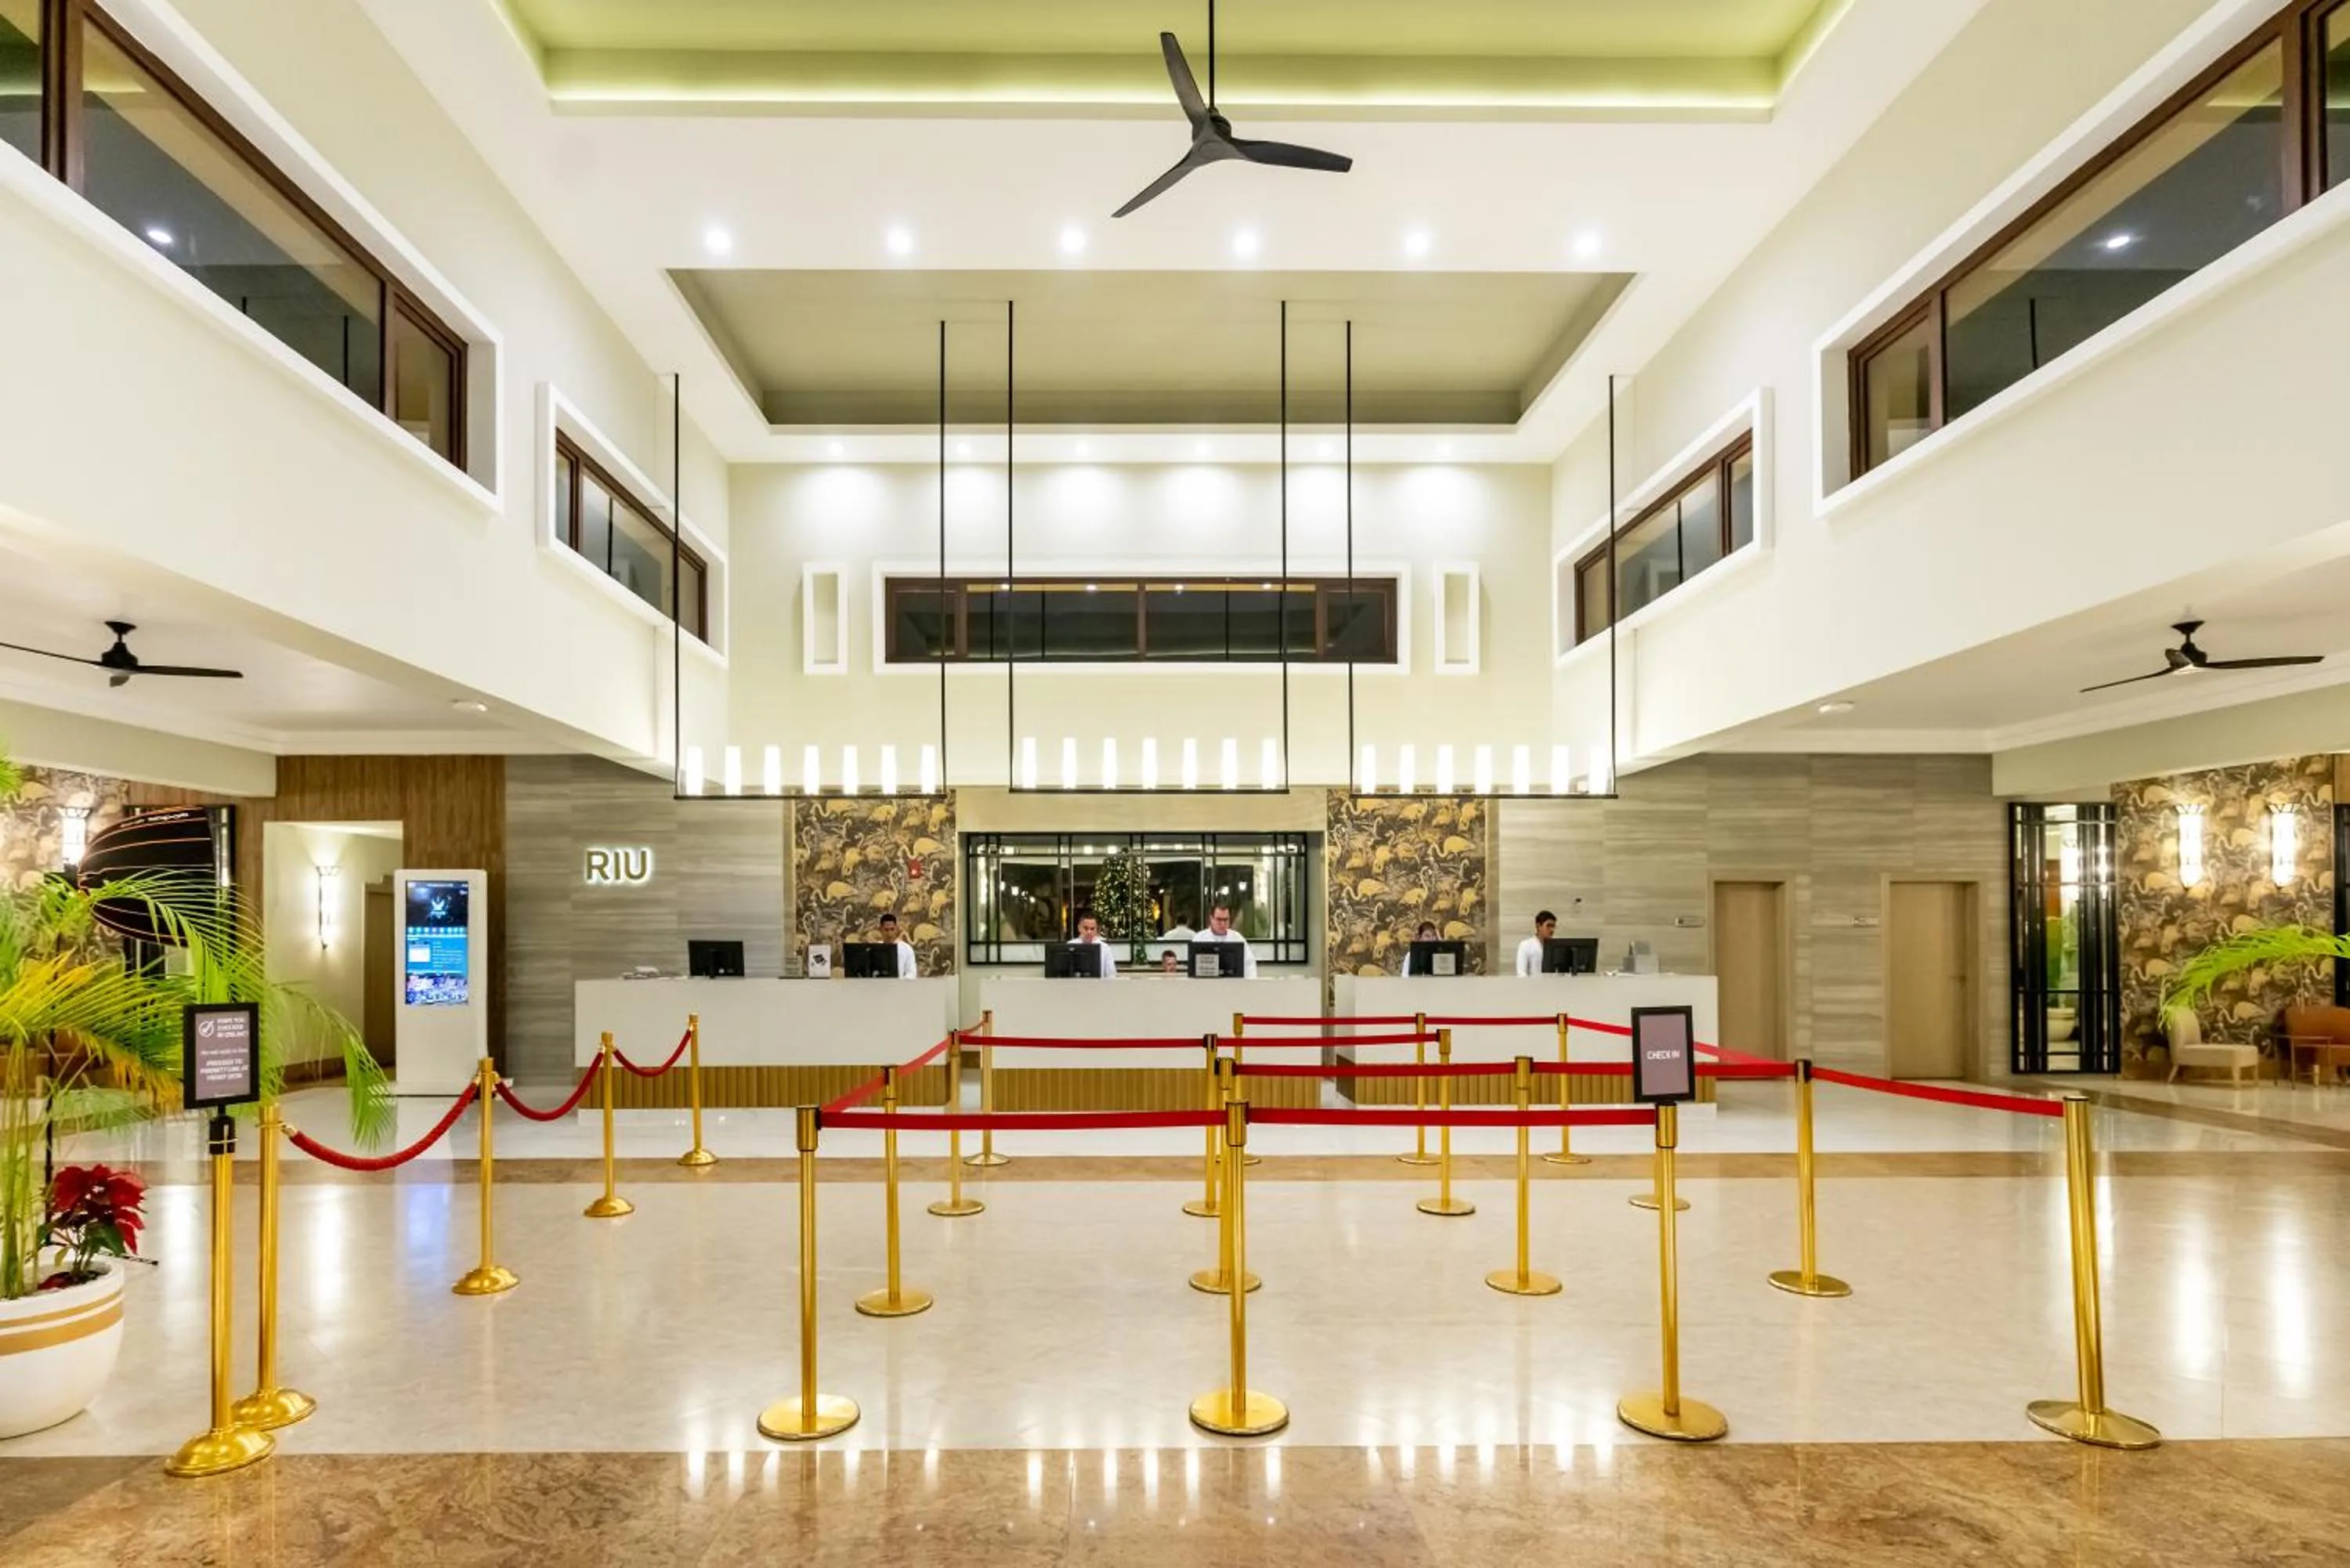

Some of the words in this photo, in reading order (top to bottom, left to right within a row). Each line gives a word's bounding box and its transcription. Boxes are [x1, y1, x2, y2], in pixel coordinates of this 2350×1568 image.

[586, 850, 647, 880] RIU
[1647, 1050, 1670, 1060] CHECK
[1671, 1050, 1680, 1059] IN
